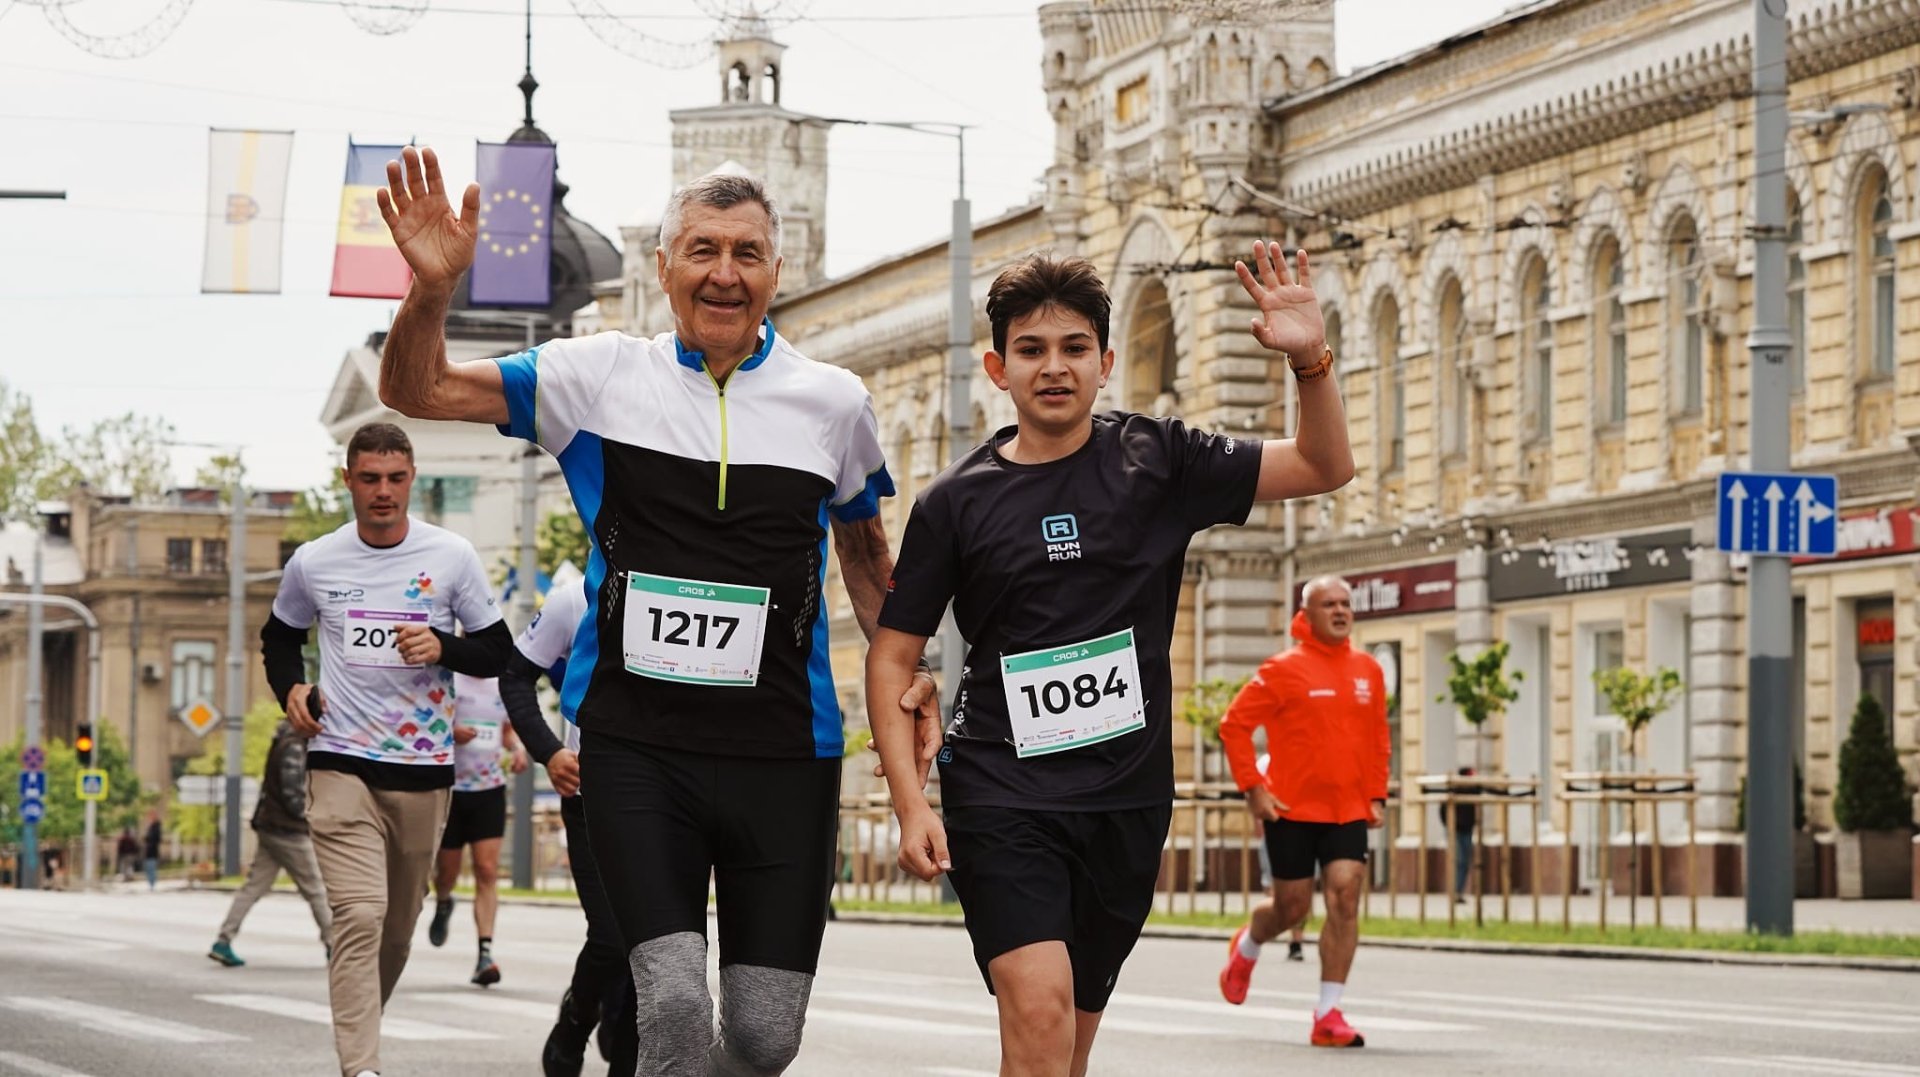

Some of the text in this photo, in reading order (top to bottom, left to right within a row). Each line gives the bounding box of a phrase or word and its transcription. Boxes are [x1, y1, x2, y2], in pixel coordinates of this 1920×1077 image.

[1049, 521, 1070, 536] R
[1046, 541, 1081, 553] RUN
[1048, 550, 1082, 562] RUN
[328, 588, 364, 599] BYD
[678, 585, 705, 597] CROS
[648, 606, 740, 650] 1217
[1053, 650, 1079, 663] CROS
[1020, 665, 1129, 719] 1084
